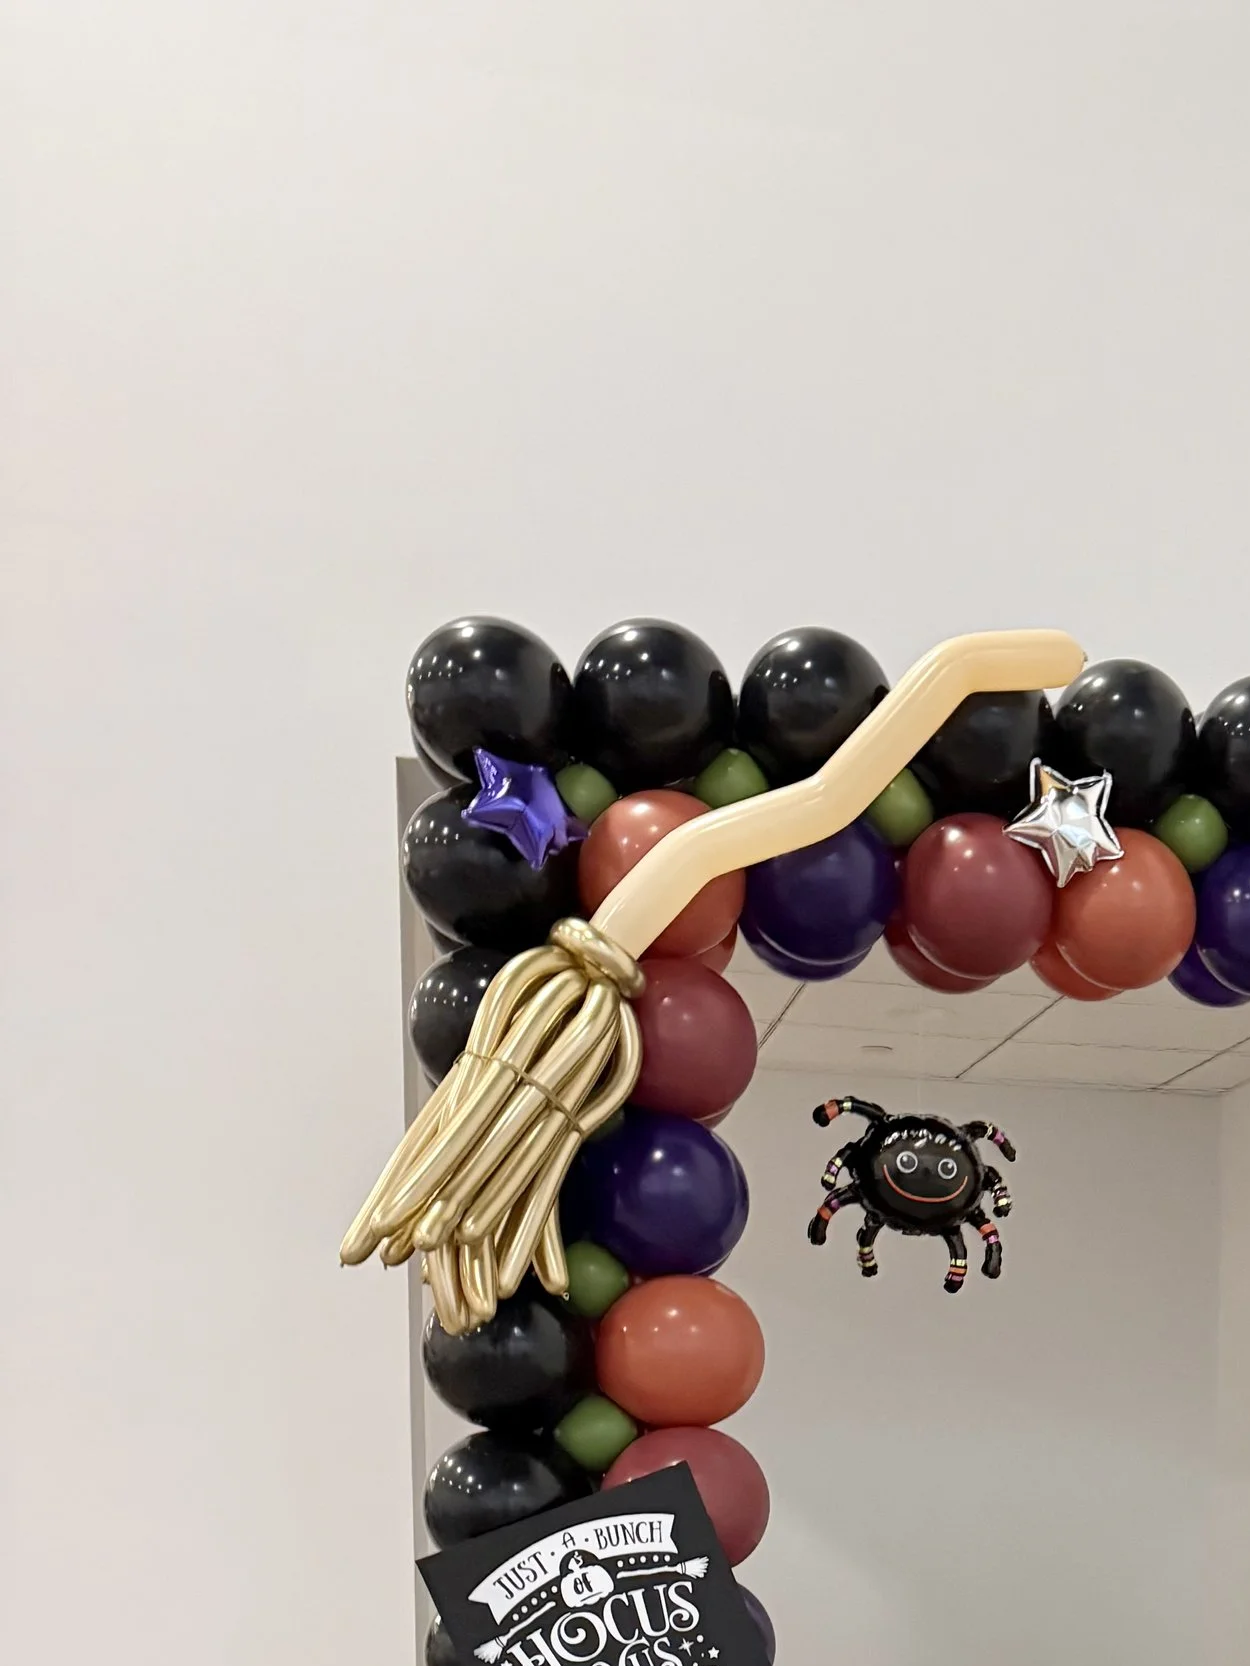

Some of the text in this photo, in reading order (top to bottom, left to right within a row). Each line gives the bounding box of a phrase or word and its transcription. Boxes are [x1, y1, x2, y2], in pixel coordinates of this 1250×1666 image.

[493, 1520, 664, 1599] JUST A BUNCH
